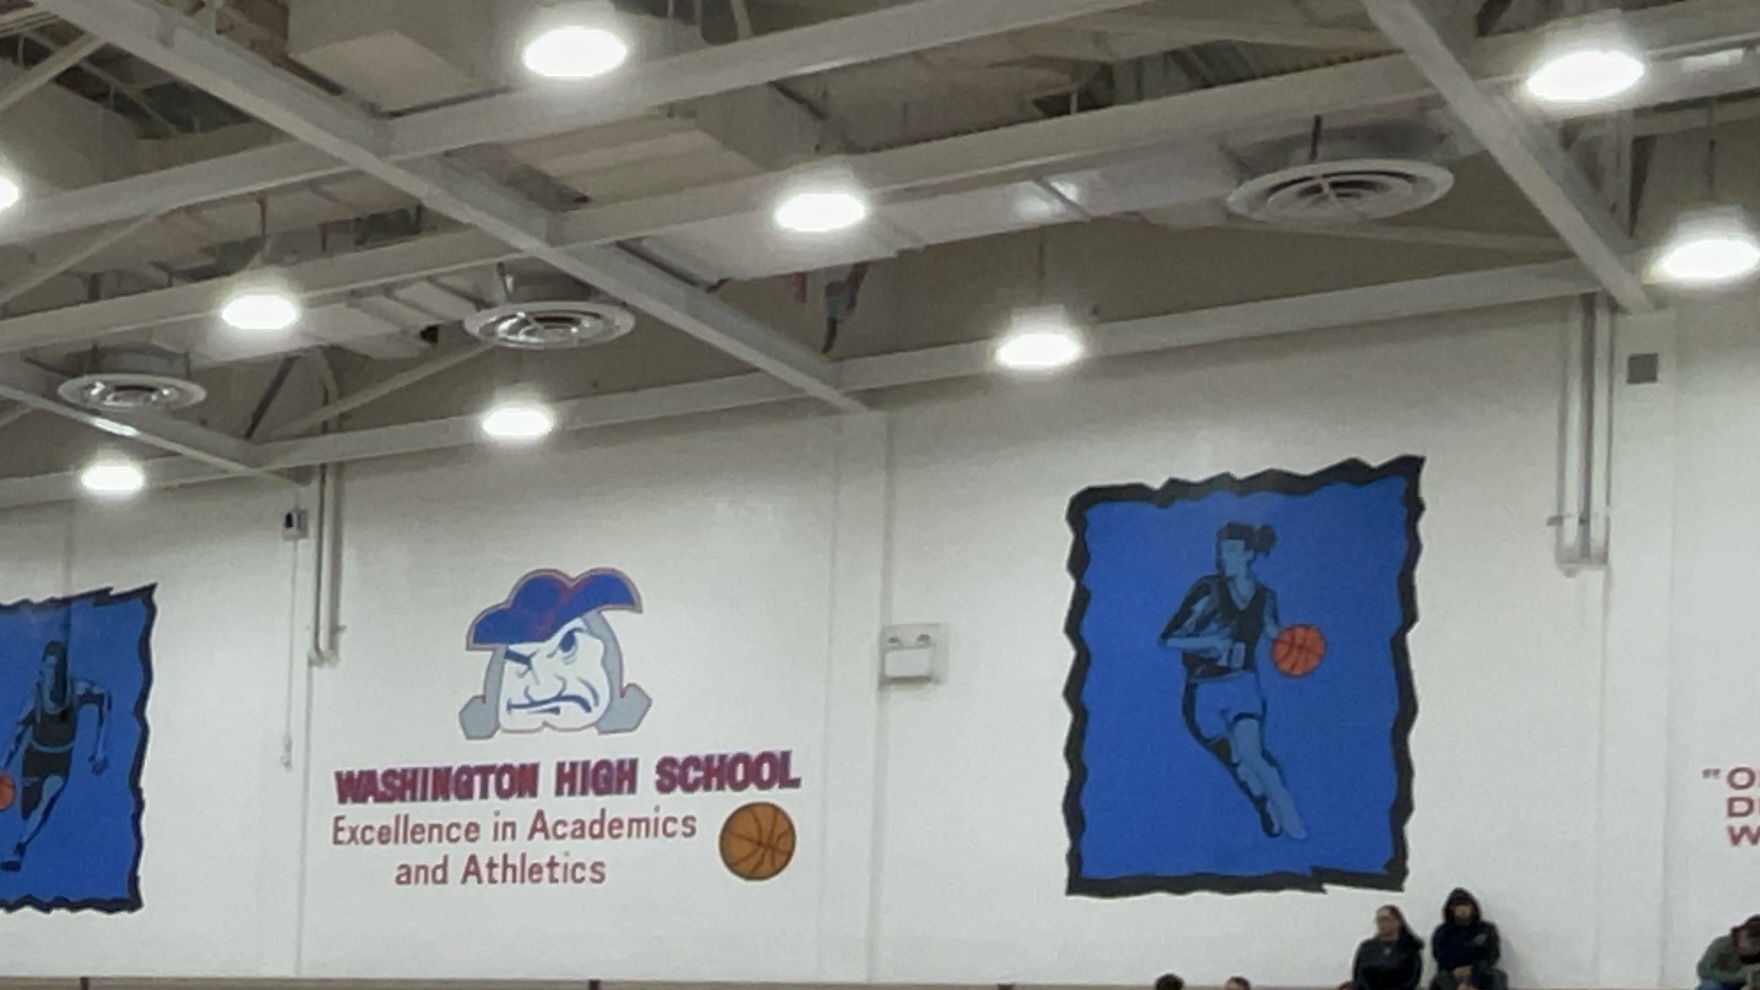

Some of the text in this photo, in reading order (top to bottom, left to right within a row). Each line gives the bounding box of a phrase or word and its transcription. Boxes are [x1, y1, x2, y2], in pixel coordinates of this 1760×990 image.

[334, 749, 803, 805] WASHINGTON HIGH SCHOOL
[331, 804, 698, 847] Excellence in Academics
[394, 850, 607, 886] and Athletics
